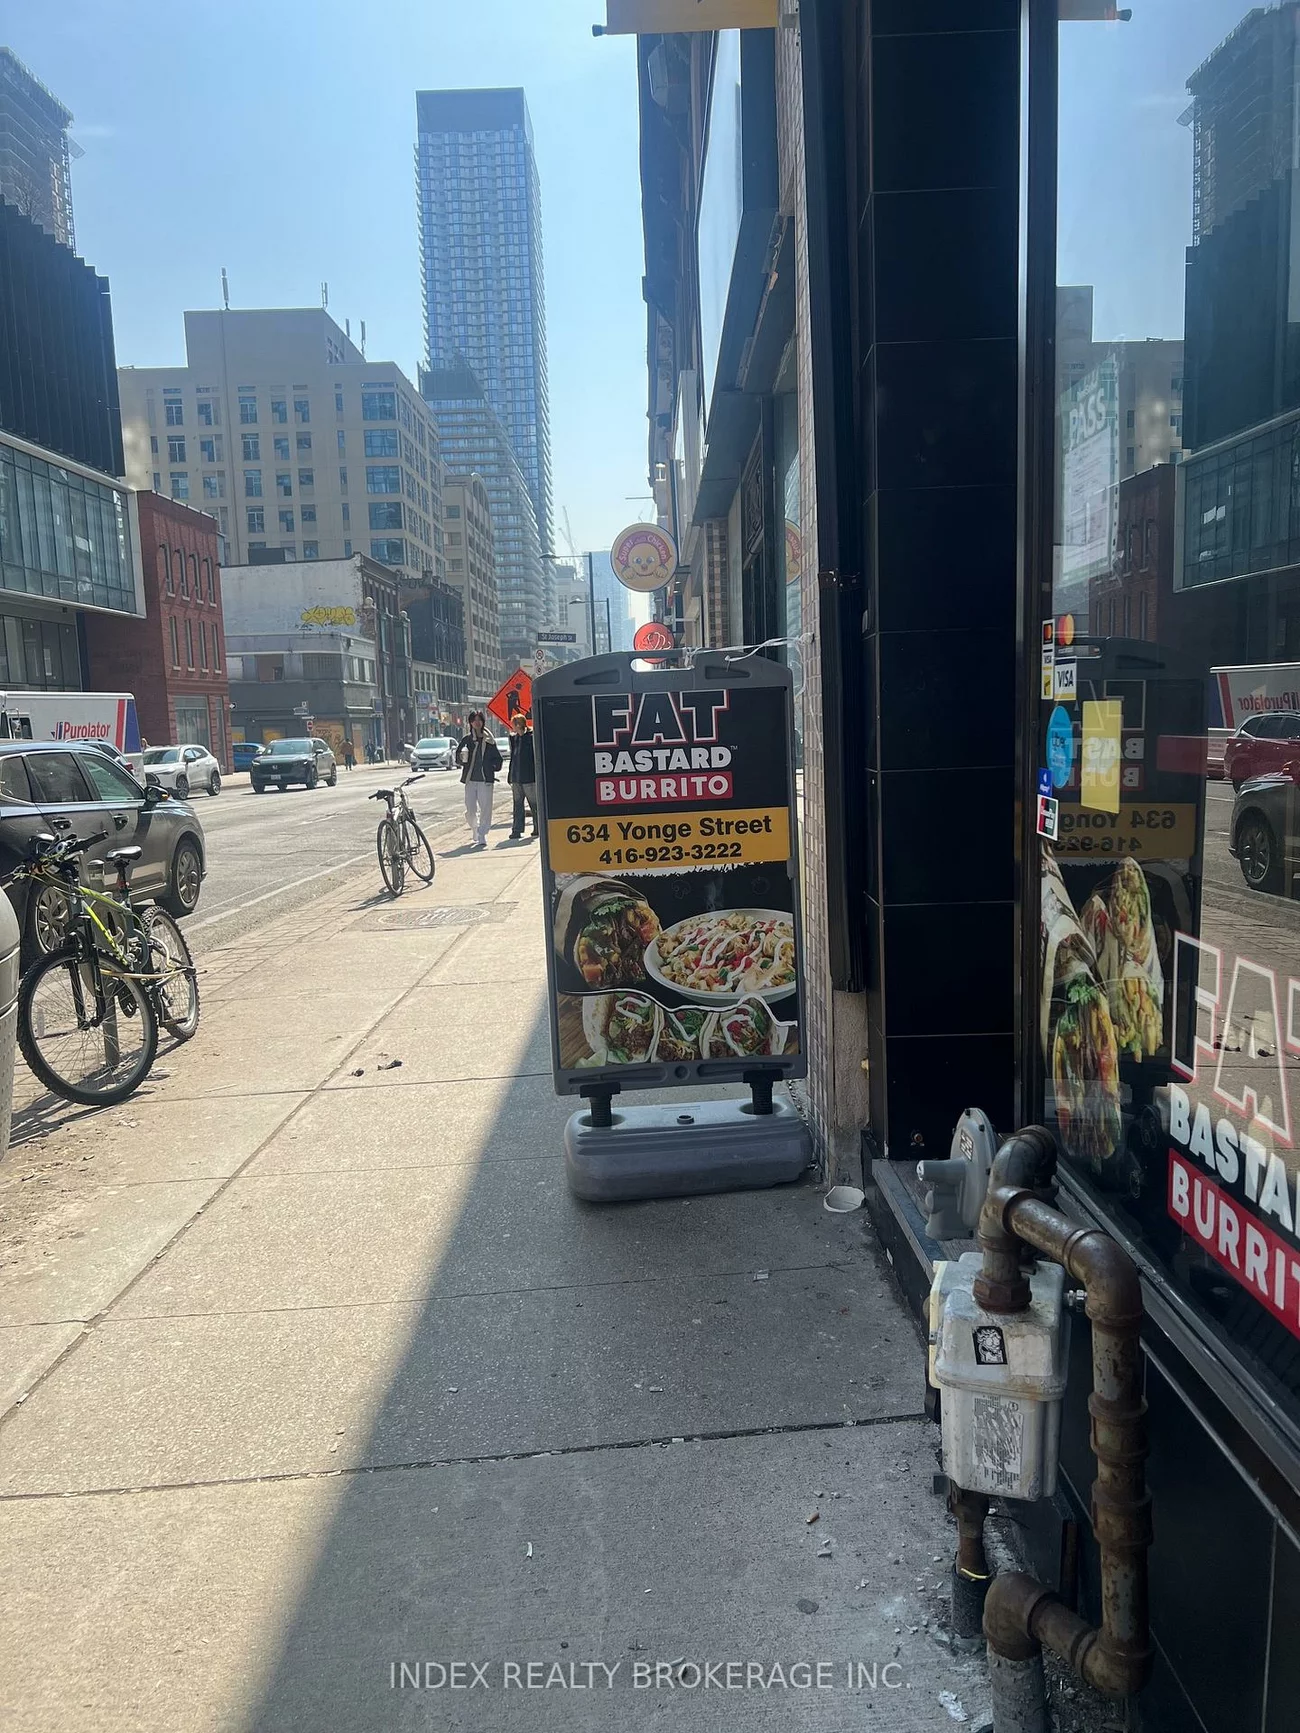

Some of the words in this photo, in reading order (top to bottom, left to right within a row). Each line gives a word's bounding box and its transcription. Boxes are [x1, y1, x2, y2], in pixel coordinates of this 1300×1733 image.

[1069, 388, 1106, 452] PASS
[1057, 669, 1074, 688] VISA
[63, 721, 111, 739] Purolator
[592, 689, 730, 747] FAT
[594, 747, 732, 774] BASTARD
[600, 775, 729, 801] BURRITO
[566, 823, 610, 844] 634
[616, 821, 692, 843] Yonge
[699, 815, 772, 837] Street
[599, 843, 742, 865] 416-923-3222
[1171, 930, 1300, 1147] FA
[1168, 1082, 1300, 1242] BASTA
